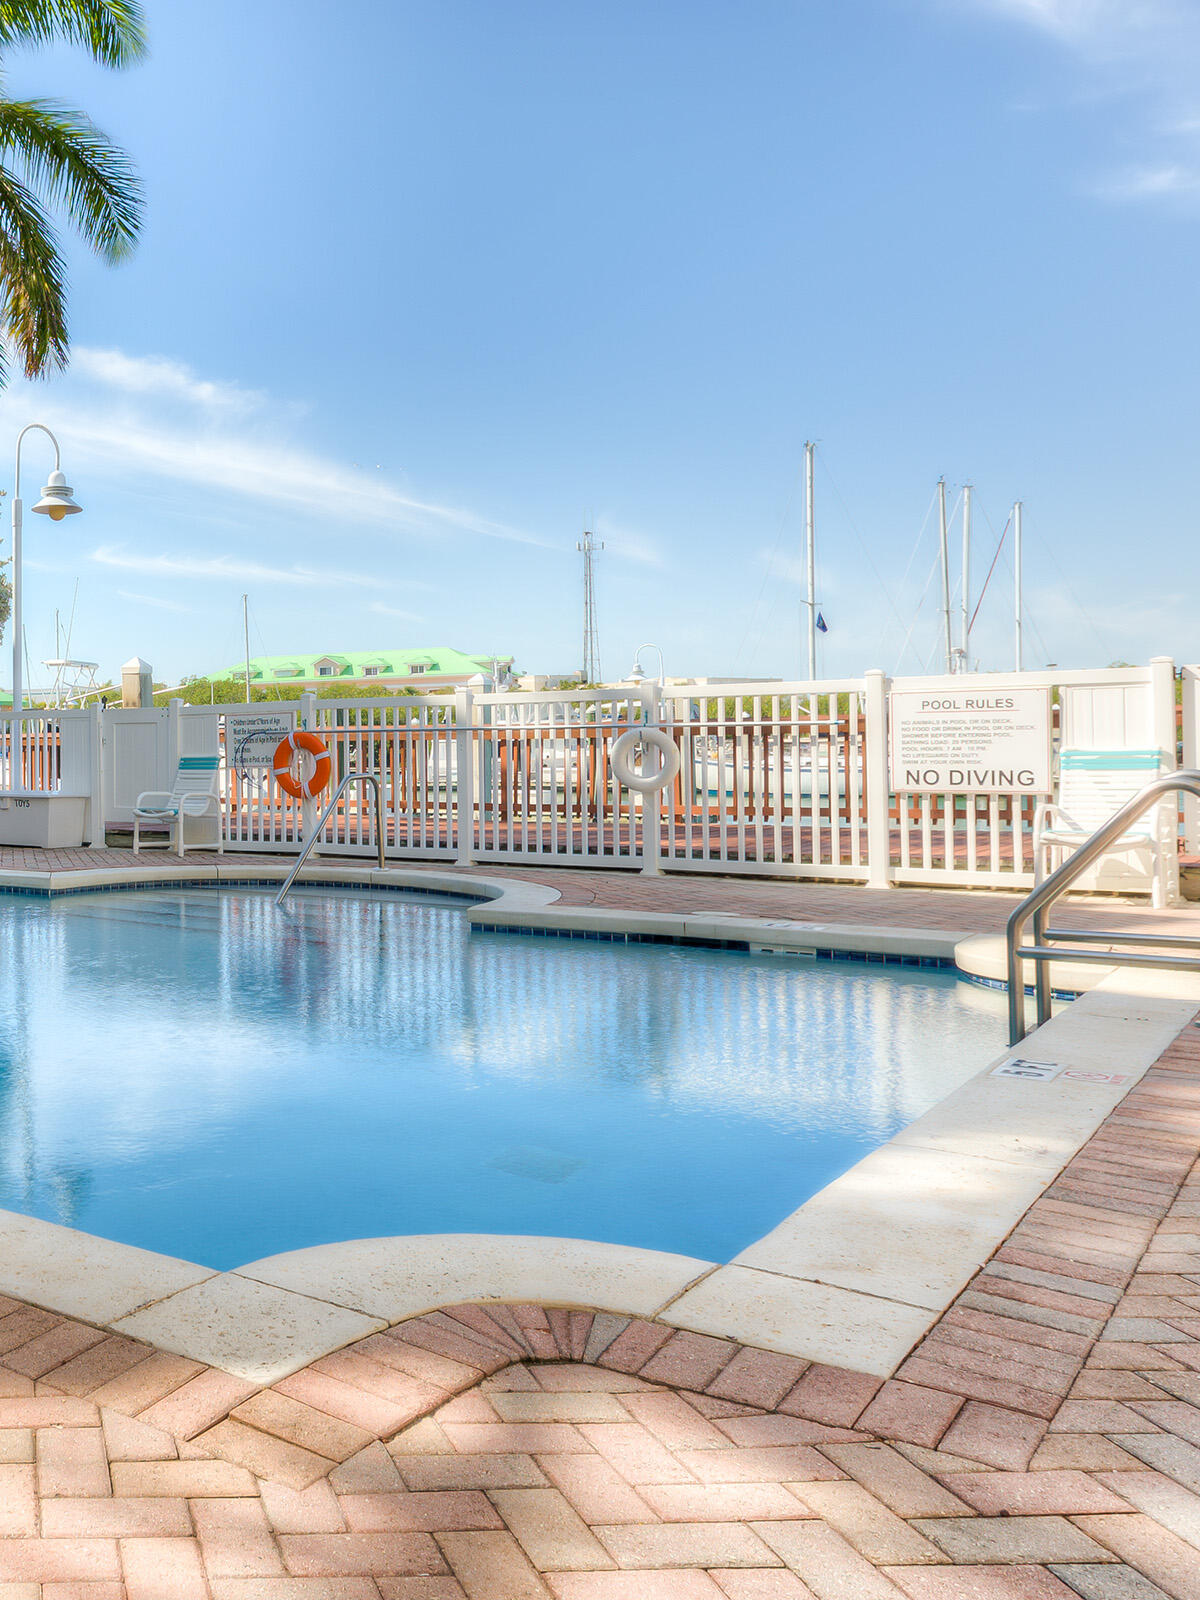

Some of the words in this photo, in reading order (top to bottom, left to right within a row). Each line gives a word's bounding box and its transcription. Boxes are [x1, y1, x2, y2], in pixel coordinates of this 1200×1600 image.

[921, 700, 961, 710] POOL
[965, 698, 1014, 709] RULES
[906, 770, 940, 786] NO
[949, 769, 1035, 786] DIVING
[14, 799, 30, 808] TOYS
[1001, 1069, 1045, 1077] 5
